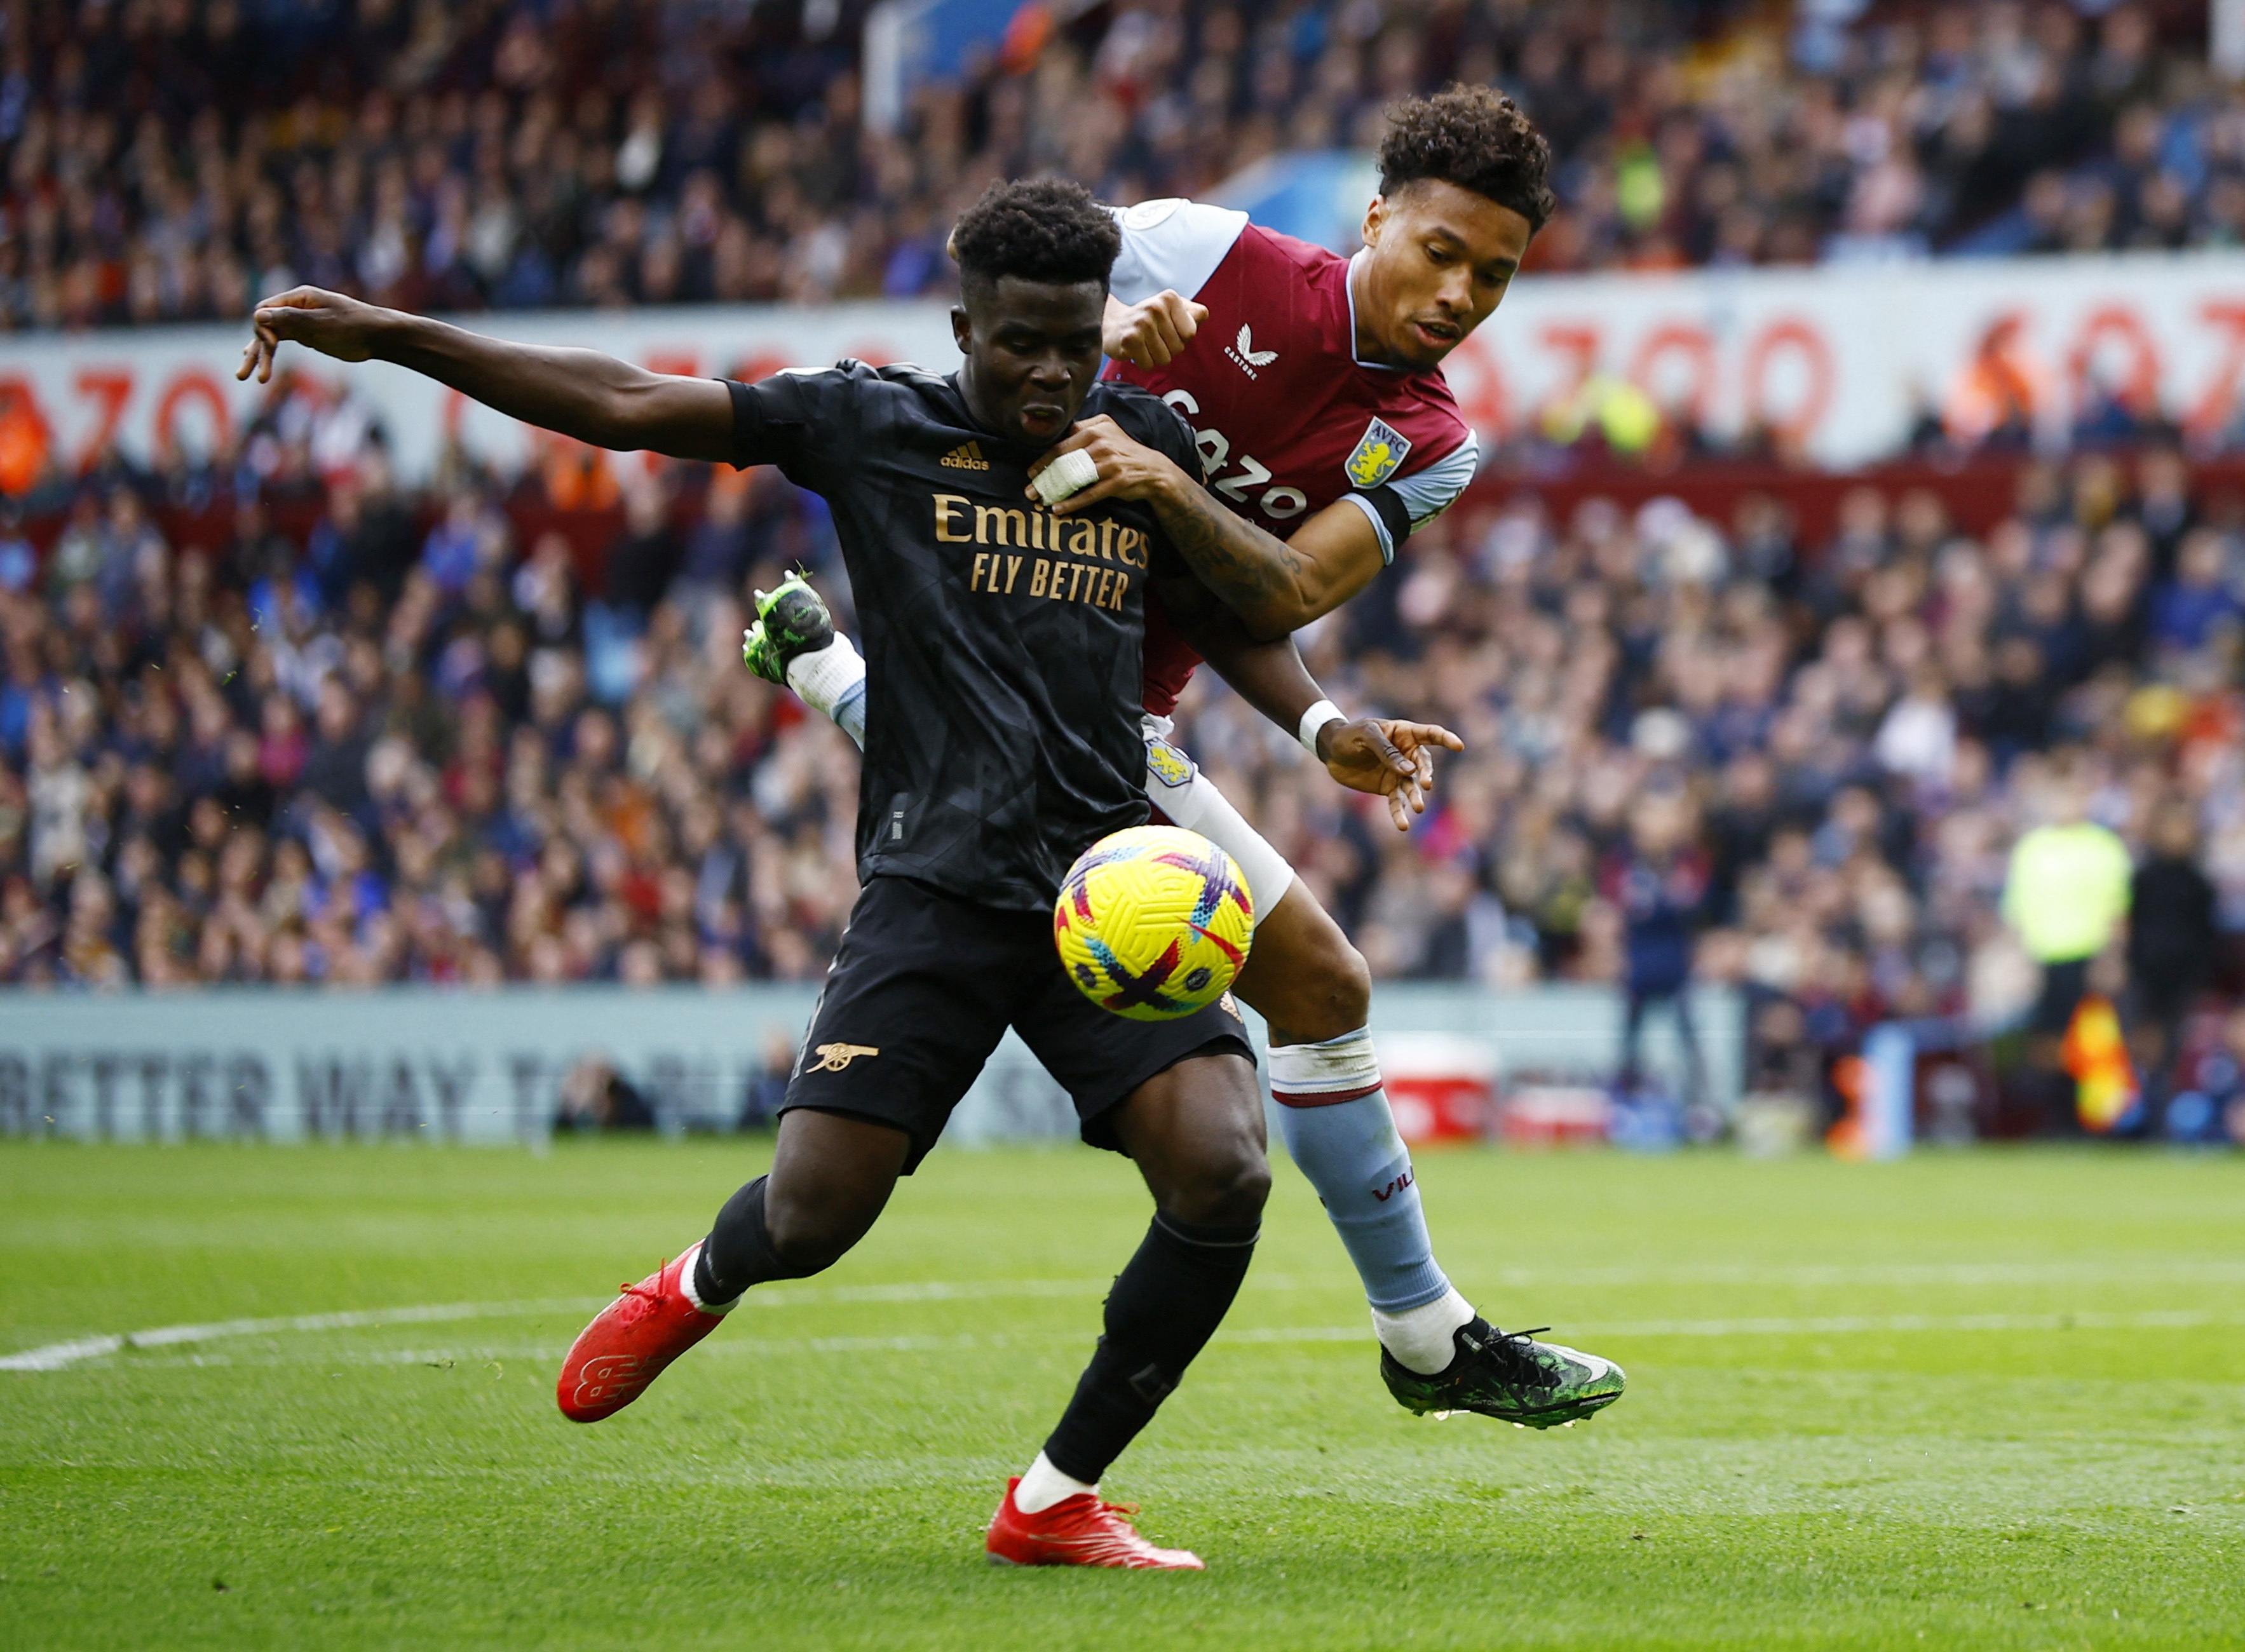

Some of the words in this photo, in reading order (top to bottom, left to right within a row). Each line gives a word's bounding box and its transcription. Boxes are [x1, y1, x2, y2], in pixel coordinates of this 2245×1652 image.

[1224, 346, 1258, 381] CASTORE
[1162, 389, 1319, 524] CAZO
[1371, 424, 1406, 454] AVFC
[940, 455, 990, 471] adidas
[932, 493, 1148, 570] Emirates
[971, 552, 1023, 595] FLY
[1029, 558, 1130, 612] BETTER
